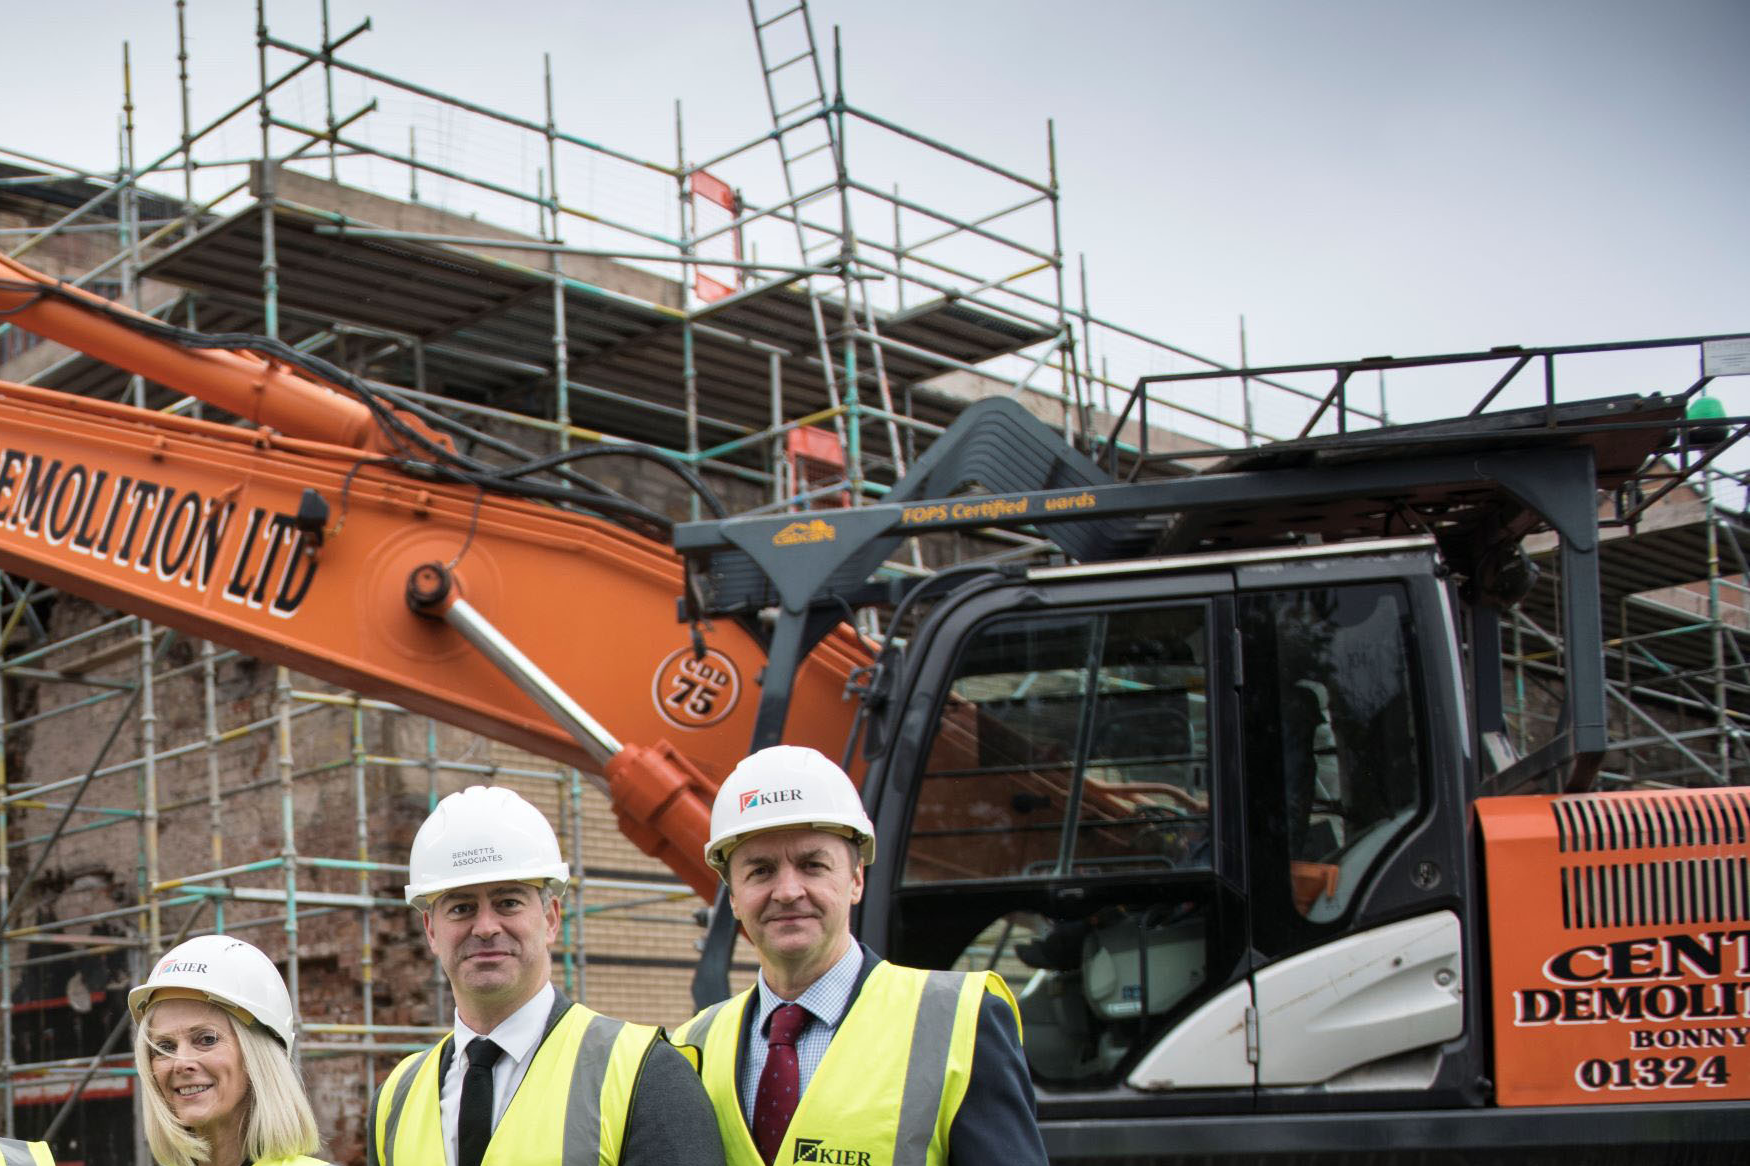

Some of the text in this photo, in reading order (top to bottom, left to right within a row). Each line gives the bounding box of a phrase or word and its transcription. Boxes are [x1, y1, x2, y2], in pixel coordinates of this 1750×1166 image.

[902, 491, 1096, 524] FOPS Certified uards
[222, 507, 319, 619] LTD
[665, 675, 720, 720] 75
[760, 788, 803, 805] KIER
[452, 846, 495, 860] BENNETTS
[452, 854, 503, 867] ASSOCIATES
[172, 962, 208, 974] KIER
[1513, 981, 1750, 1027] DEMOLI
[1574, 1054, 1732, 1092] 01324
[819, 1148, 872, 1166] KIER
